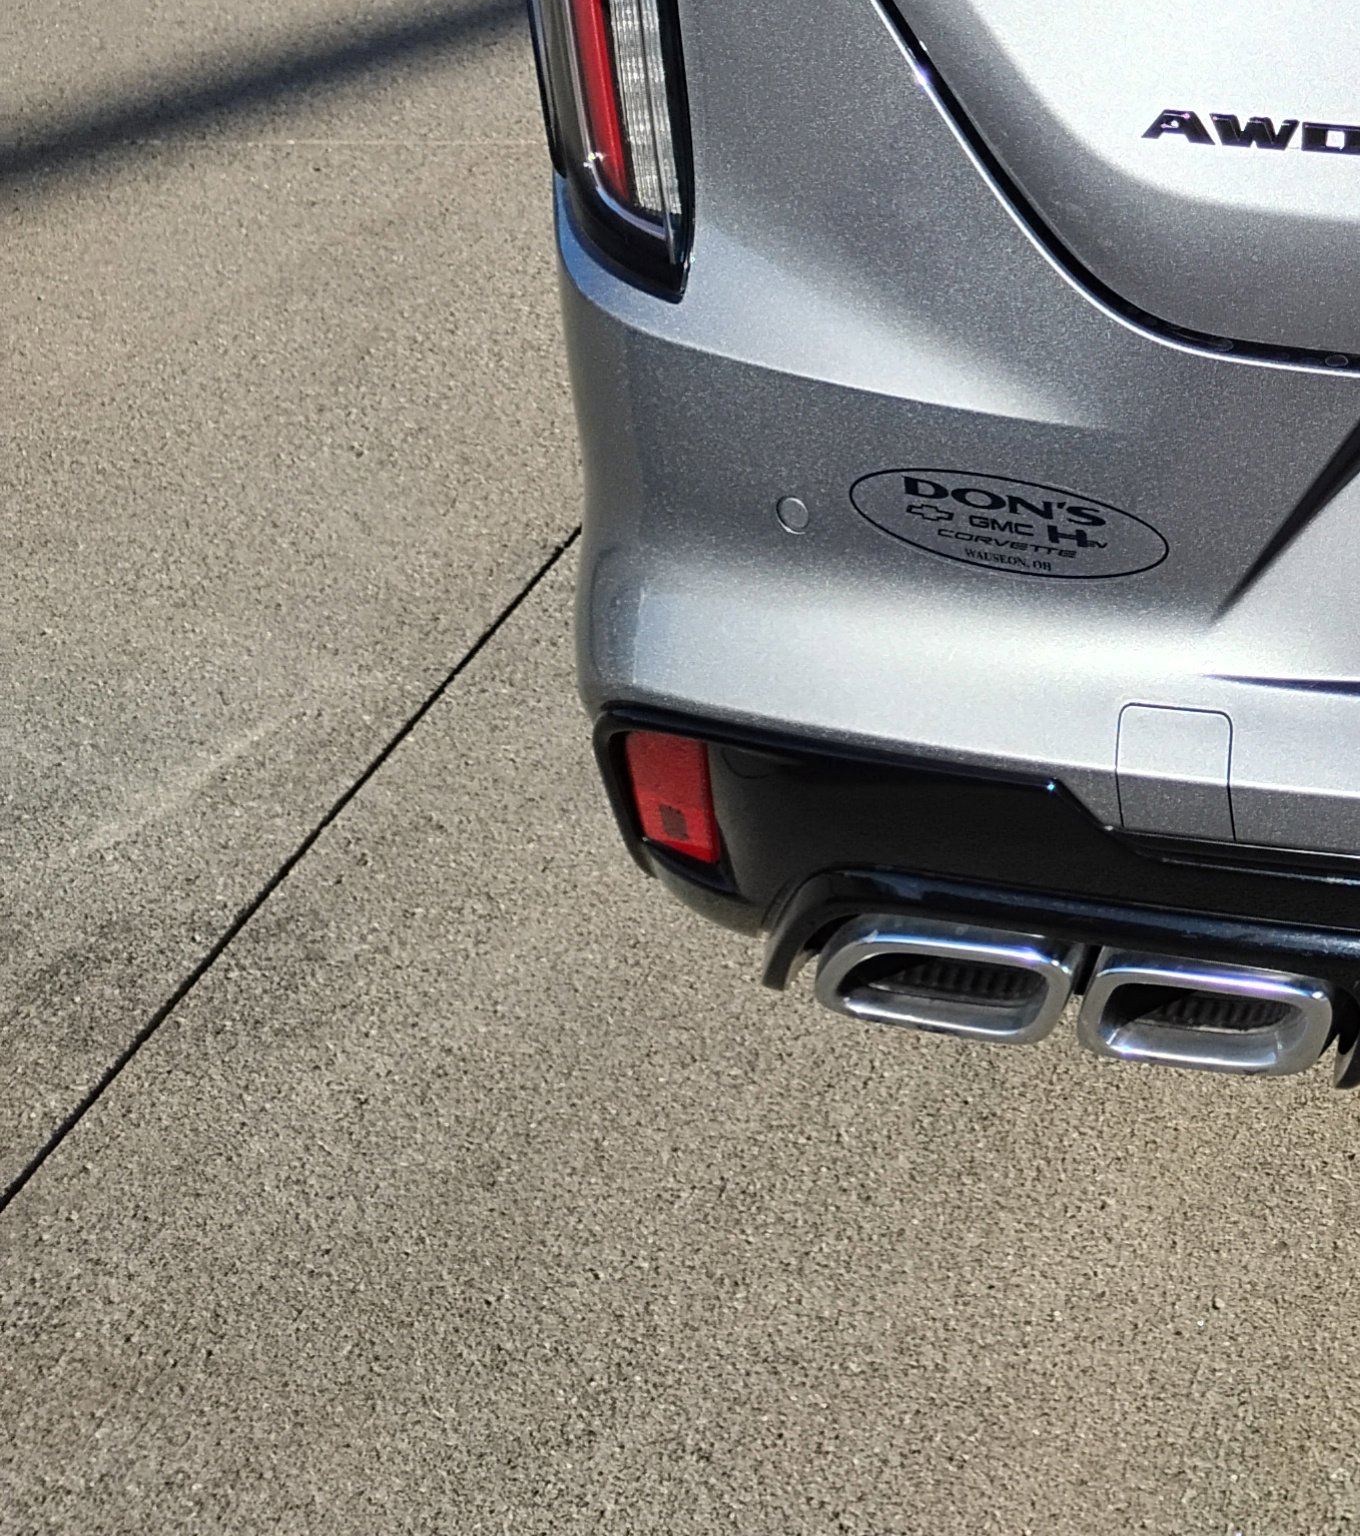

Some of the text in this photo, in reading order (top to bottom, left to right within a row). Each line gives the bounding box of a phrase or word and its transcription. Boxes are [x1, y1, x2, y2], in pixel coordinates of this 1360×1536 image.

[902, 475, 1106, 526] DON'S
[969, 515, 1034, 537] GMC
[937, 528, 1077, 558] CORVETTE
[964, 548, 1052, 571] WAUSEON, OH
